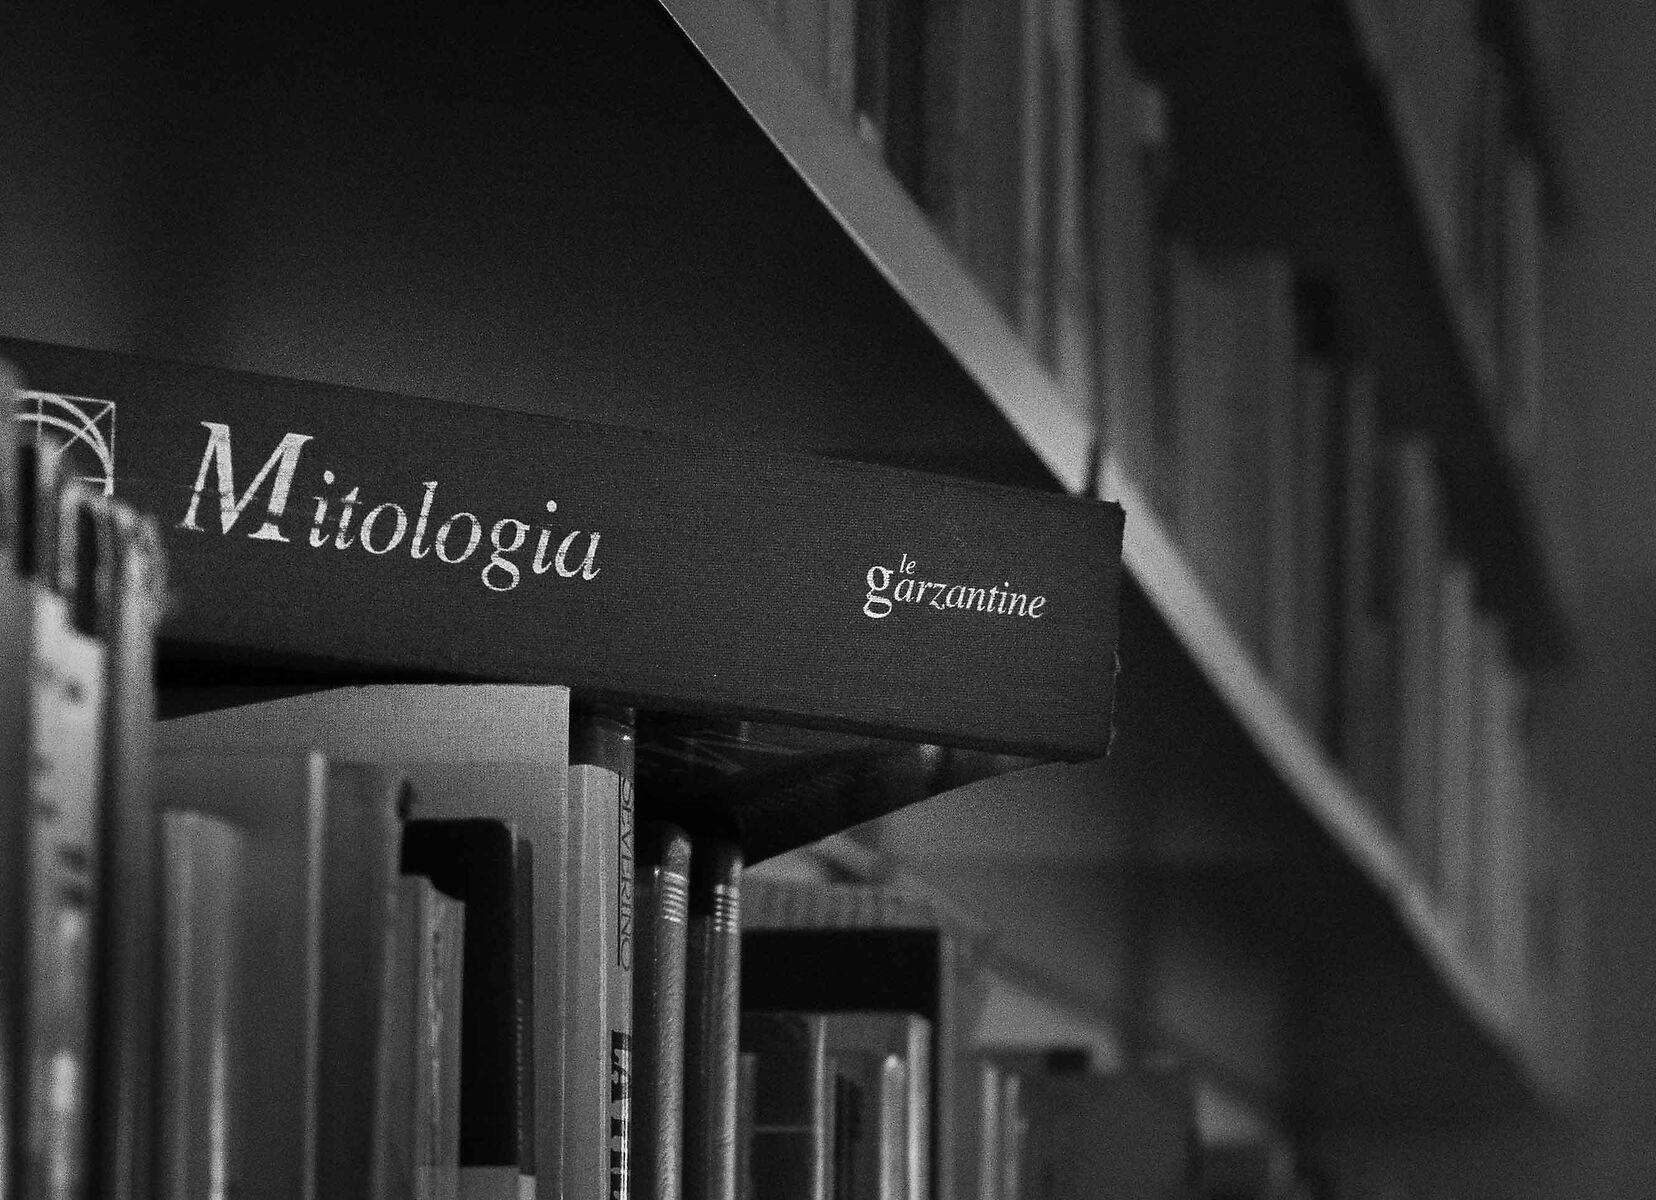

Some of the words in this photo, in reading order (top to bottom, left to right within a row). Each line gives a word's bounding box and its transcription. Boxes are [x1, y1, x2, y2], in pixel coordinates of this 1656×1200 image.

[174, 419, 603, 593] Mitologia
[863, 565, 1047, 619] garzantine
[899, 553, 917, 575] le
[620, 777, 635, 973] SEVERINO
